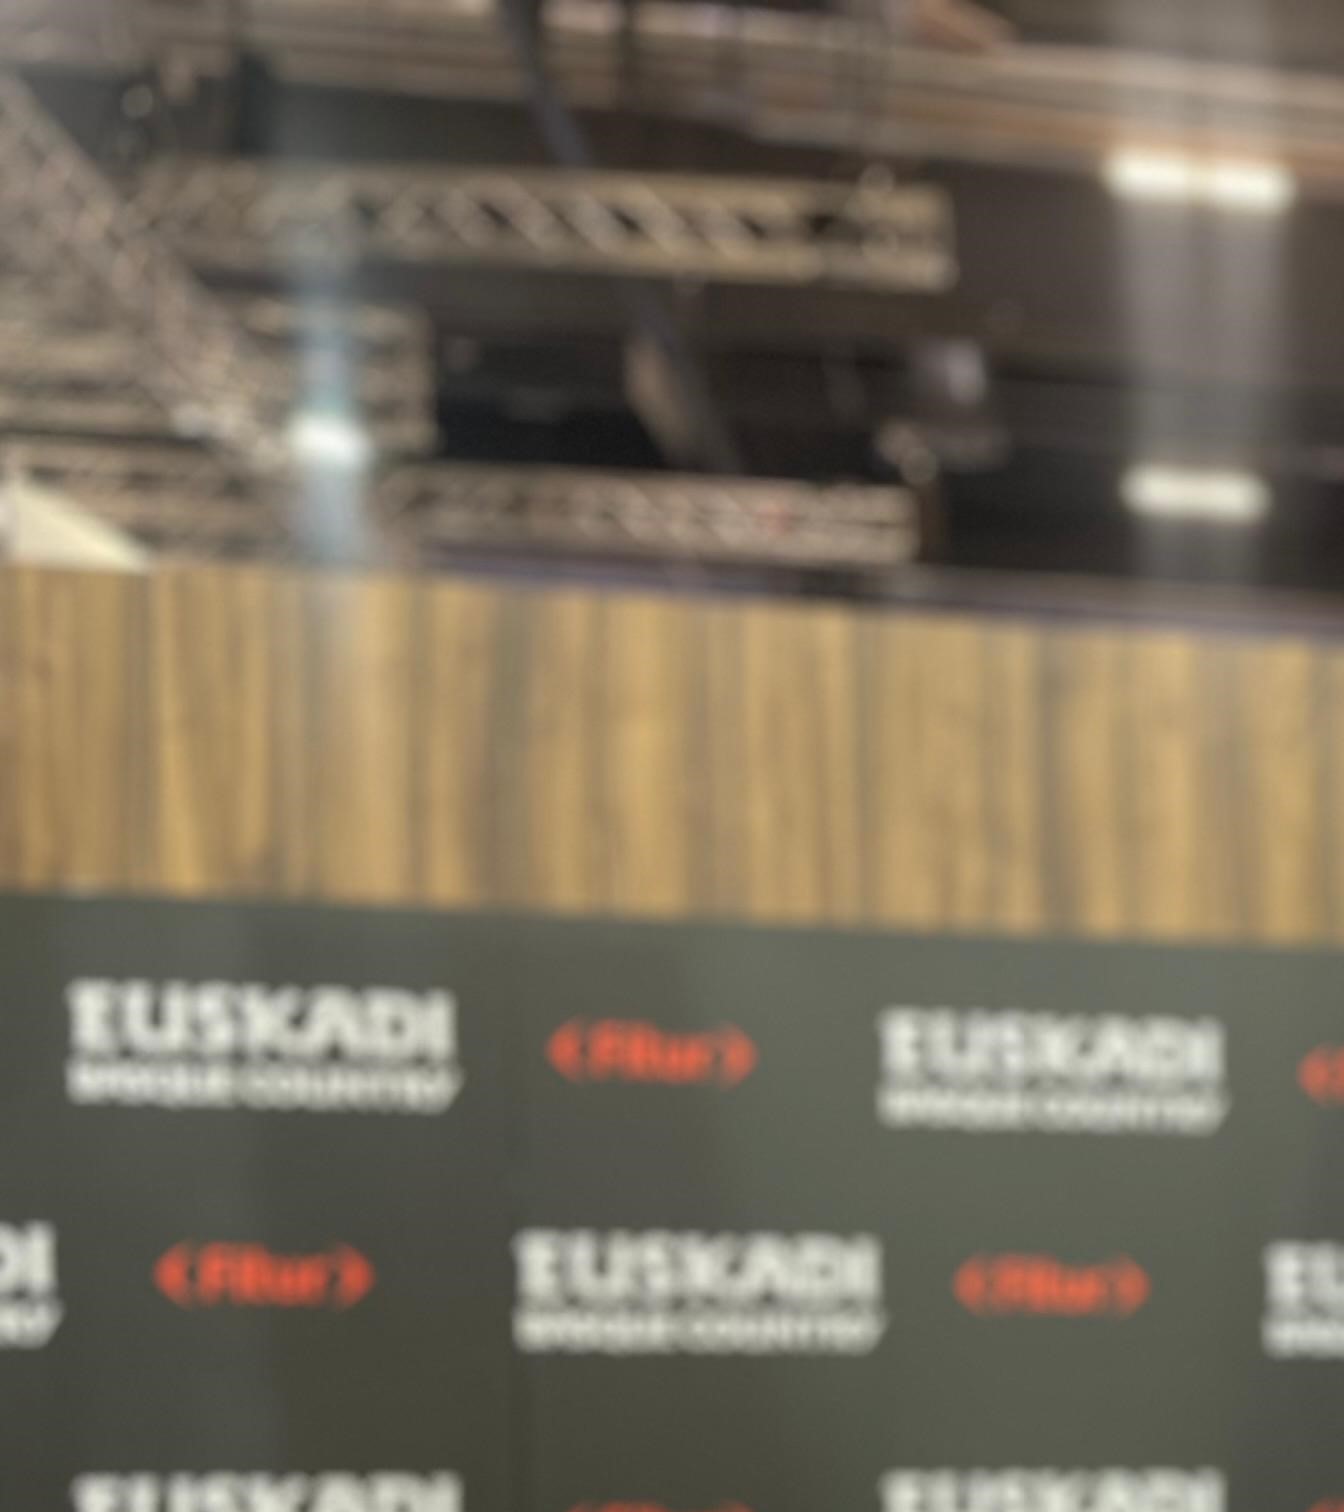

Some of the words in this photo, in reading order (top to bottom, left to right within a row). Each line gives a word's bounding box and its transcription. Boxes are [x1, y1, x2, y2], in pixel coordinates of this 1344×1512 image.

[67, 977, 458, 1061] EUSKADI
[879, 1007, 1227, 1086] EUSKADI
[512, 1227, 882, 1307] EUSKADI
